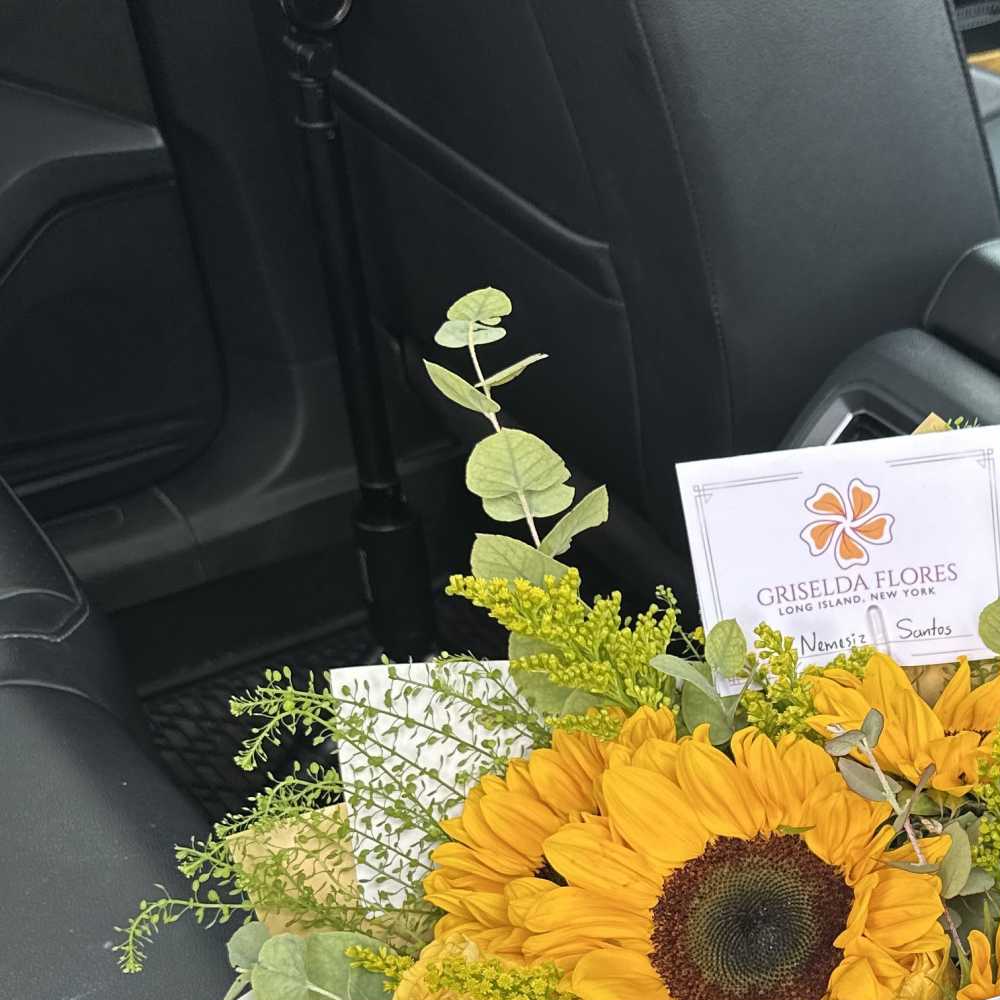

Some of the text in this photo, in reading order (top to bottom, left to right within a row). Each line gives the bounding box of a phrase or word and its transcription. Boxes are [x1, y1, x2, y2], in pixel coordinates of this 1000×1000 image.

[757, 563, 958, 606] GRISELDA FLORES
[778, 586, 935, 616] LONG ISLAND, NEW YORK
[896, 617, 952, 640] Santos
